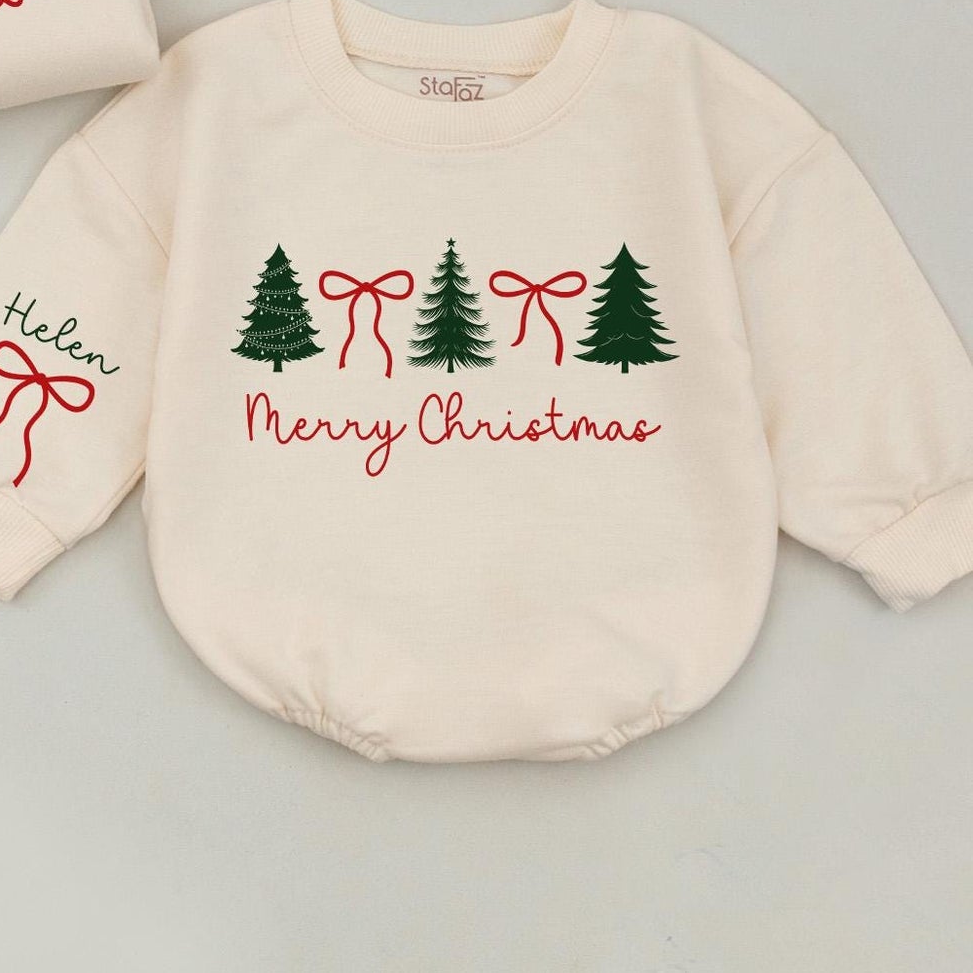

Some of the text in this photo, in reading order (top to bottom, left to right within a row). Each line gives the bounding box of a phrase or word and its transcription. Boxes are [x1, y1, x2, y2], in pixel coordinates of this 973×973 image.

[3, 291, 121, 375] Helen
[245, 391, 662, 478] Merry Christmas
